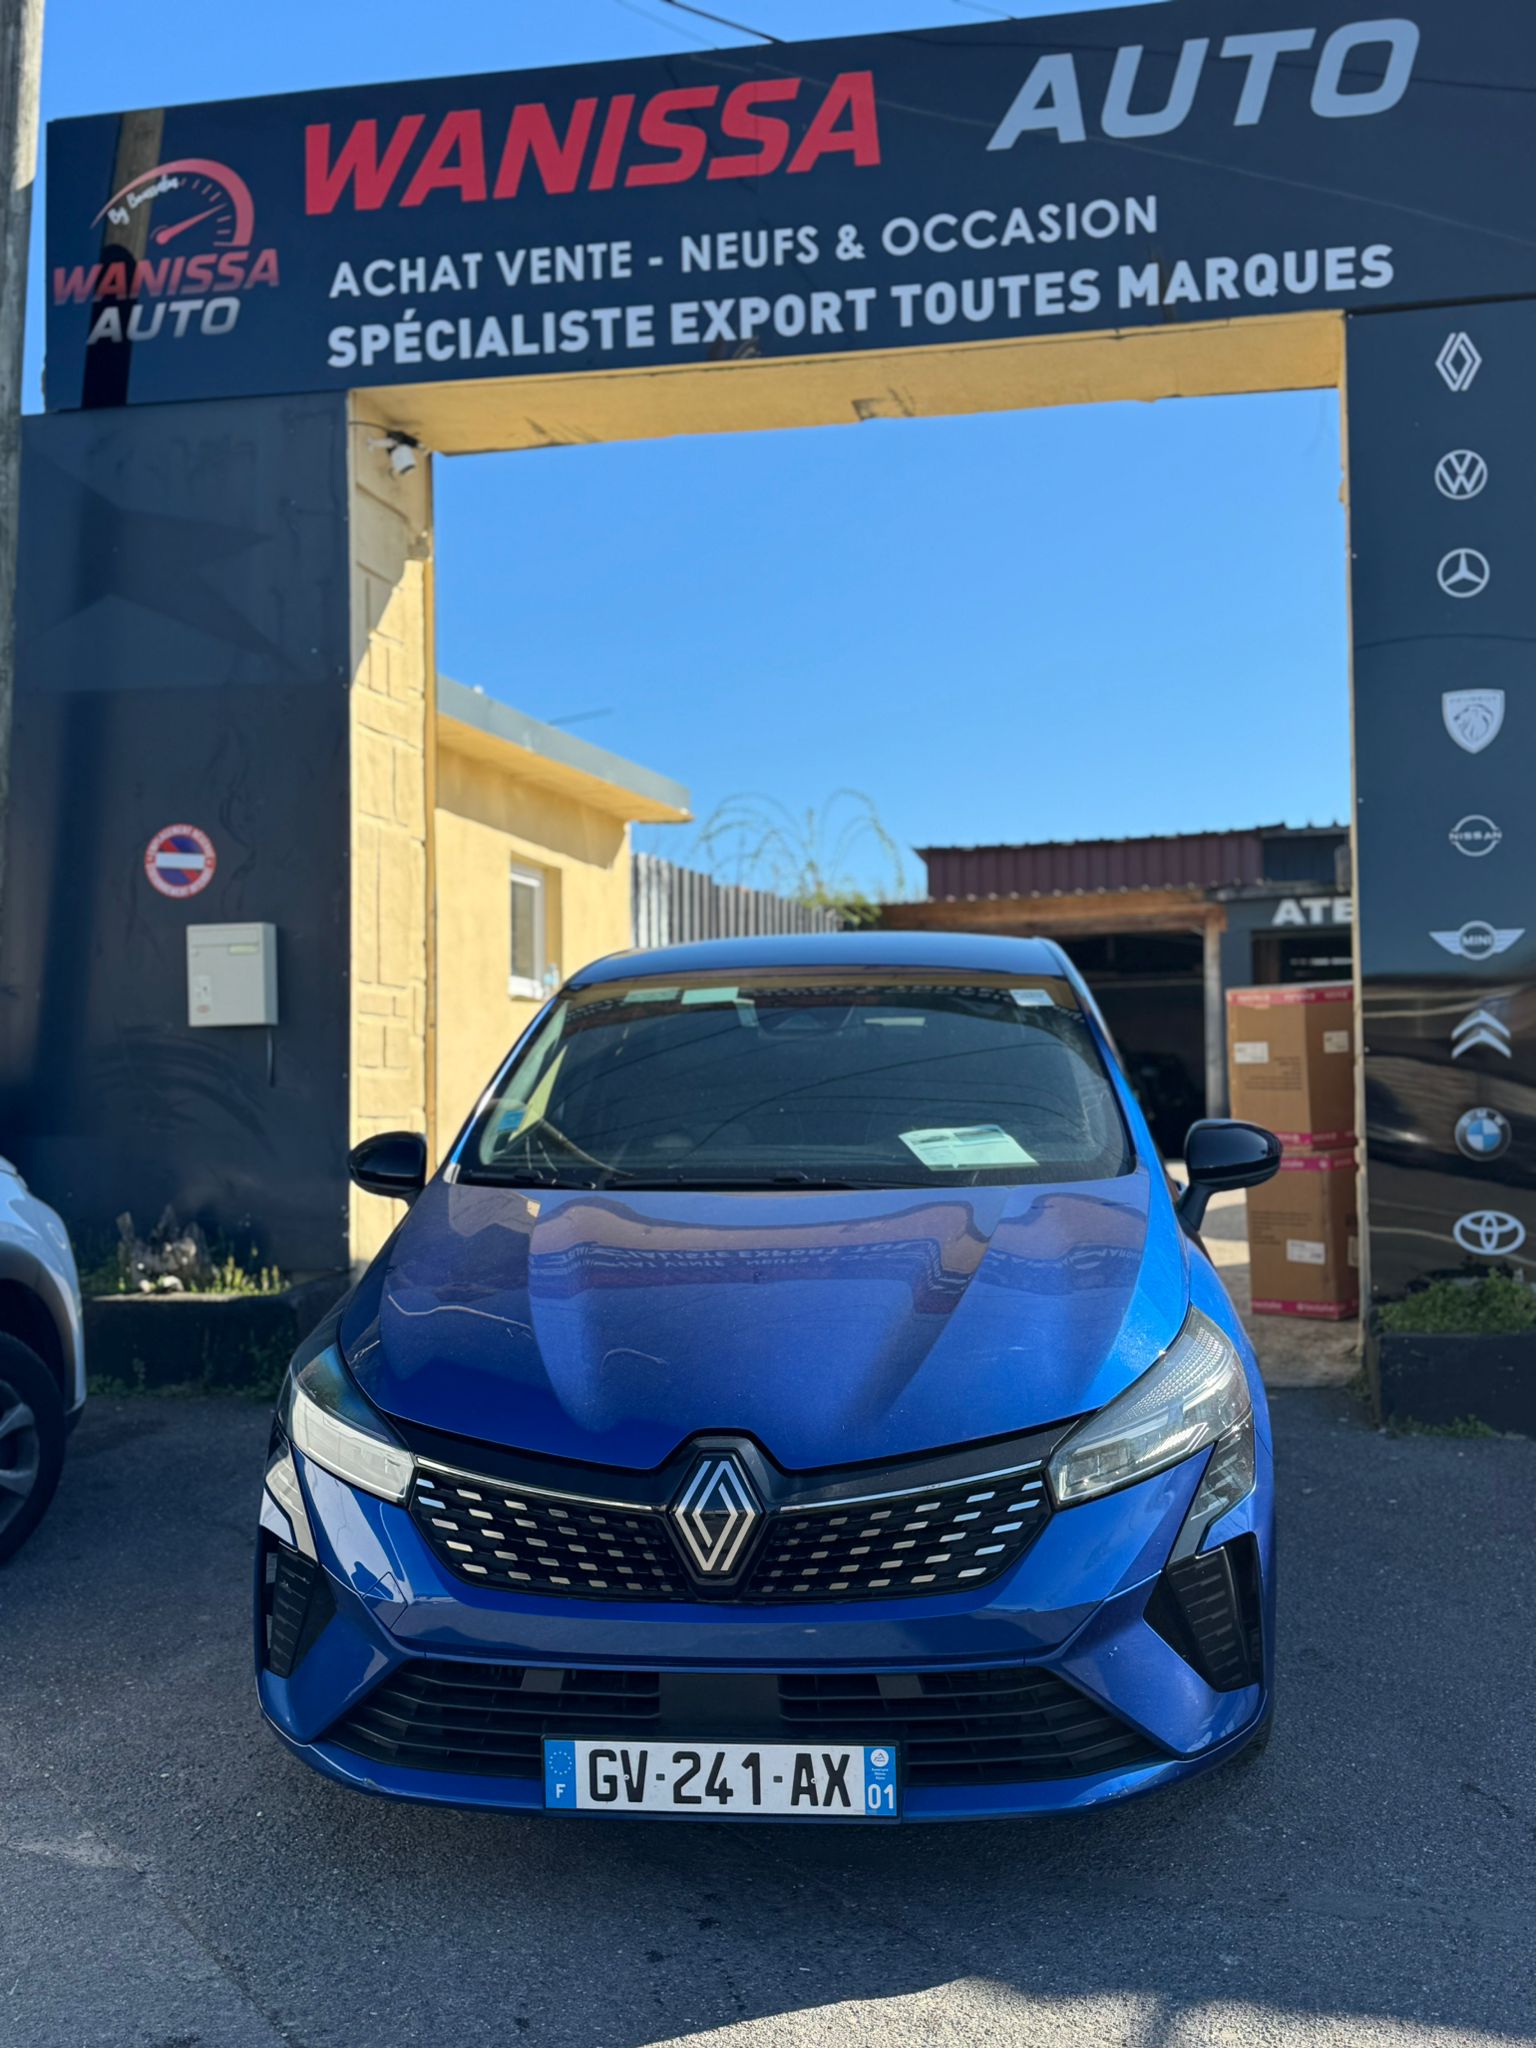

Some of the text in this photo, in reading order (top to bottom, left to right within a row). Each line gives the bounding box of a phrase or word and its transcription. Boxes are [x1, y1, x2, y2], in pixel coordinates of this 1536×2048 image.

[305, 18, 1420, 215] WANISSA AUTO
[329, 252, 482, 298] ACHAT
[496, 241, 632, 287] VENTE
[681, 225, 819, 273] NEUFS
[835, 224, 866, 260] &
[882, 195, 1157, 256] OCCASION
[53, 249, 279, 305] WANISSA
[87, 296, 240, 345] AUTO
[327, 244, 1394, 368] SPÉCIALISTE EXPORT TOUTES MARQUES
[1449, 831, 1502, 841] NISSAN
[1461, 934, 1492, 947] MINI
[555, 1783, 566, 1799] F
[588, 1749, 851, 1807] GV-241-AX
[867, 1783, 894, 1810] 01
